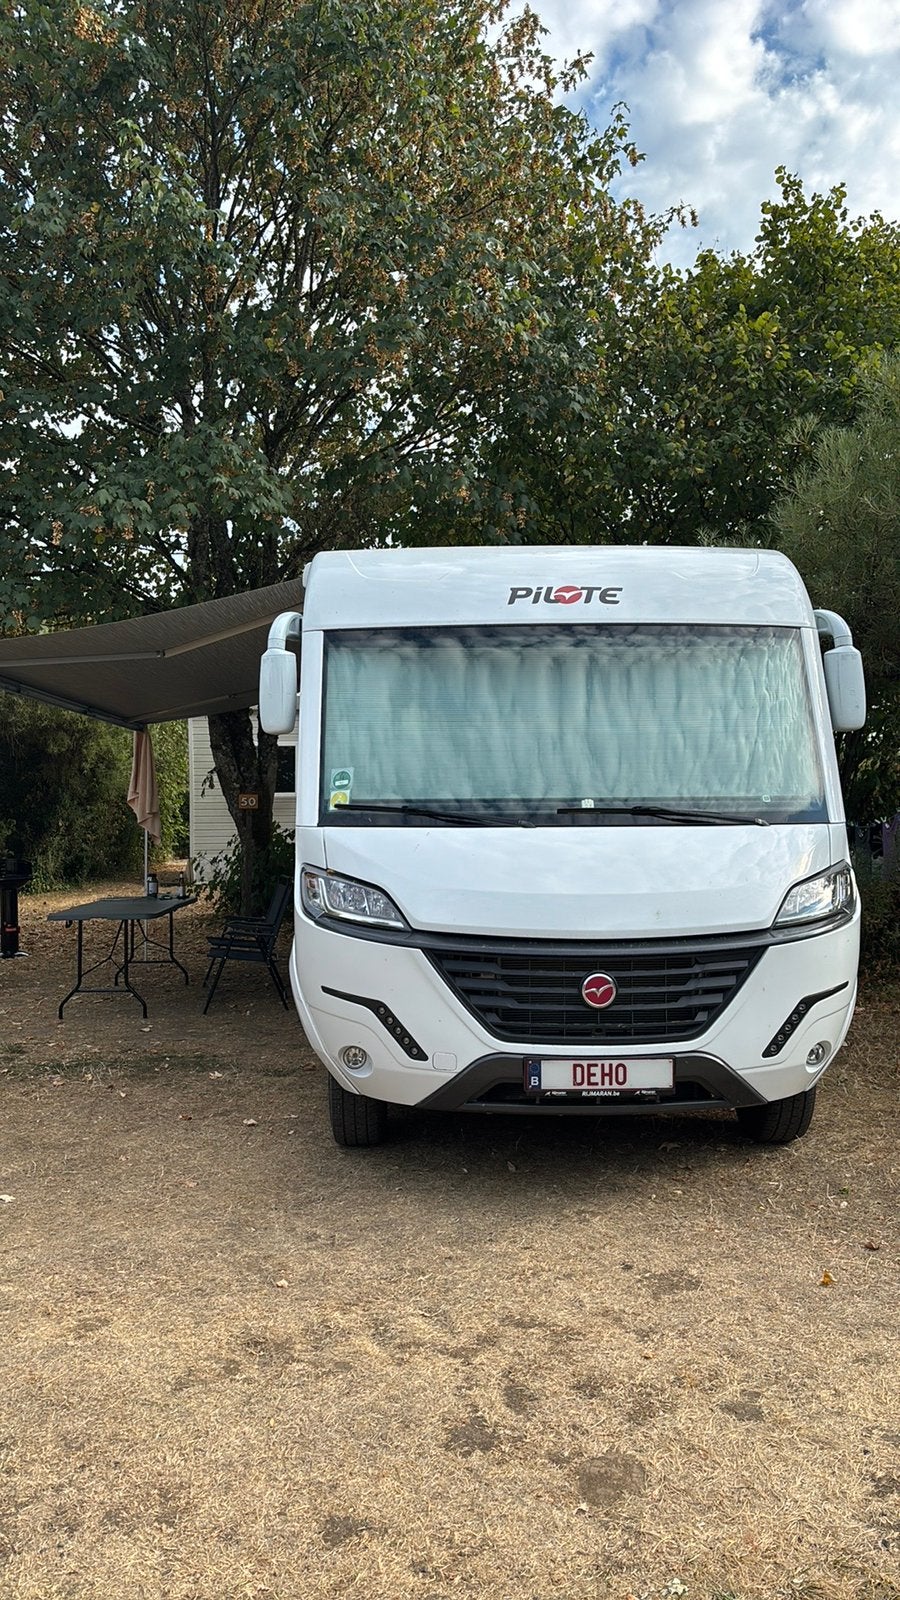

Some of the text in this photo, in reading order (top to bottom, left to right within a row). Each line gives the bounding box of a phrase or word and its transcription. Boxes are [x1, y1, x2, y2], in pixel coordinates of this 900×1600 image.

[240, 797, 256, 807] 50
[572, 1063, 627, 1086] DEHO
[531, 1076, 539, 1085] B
